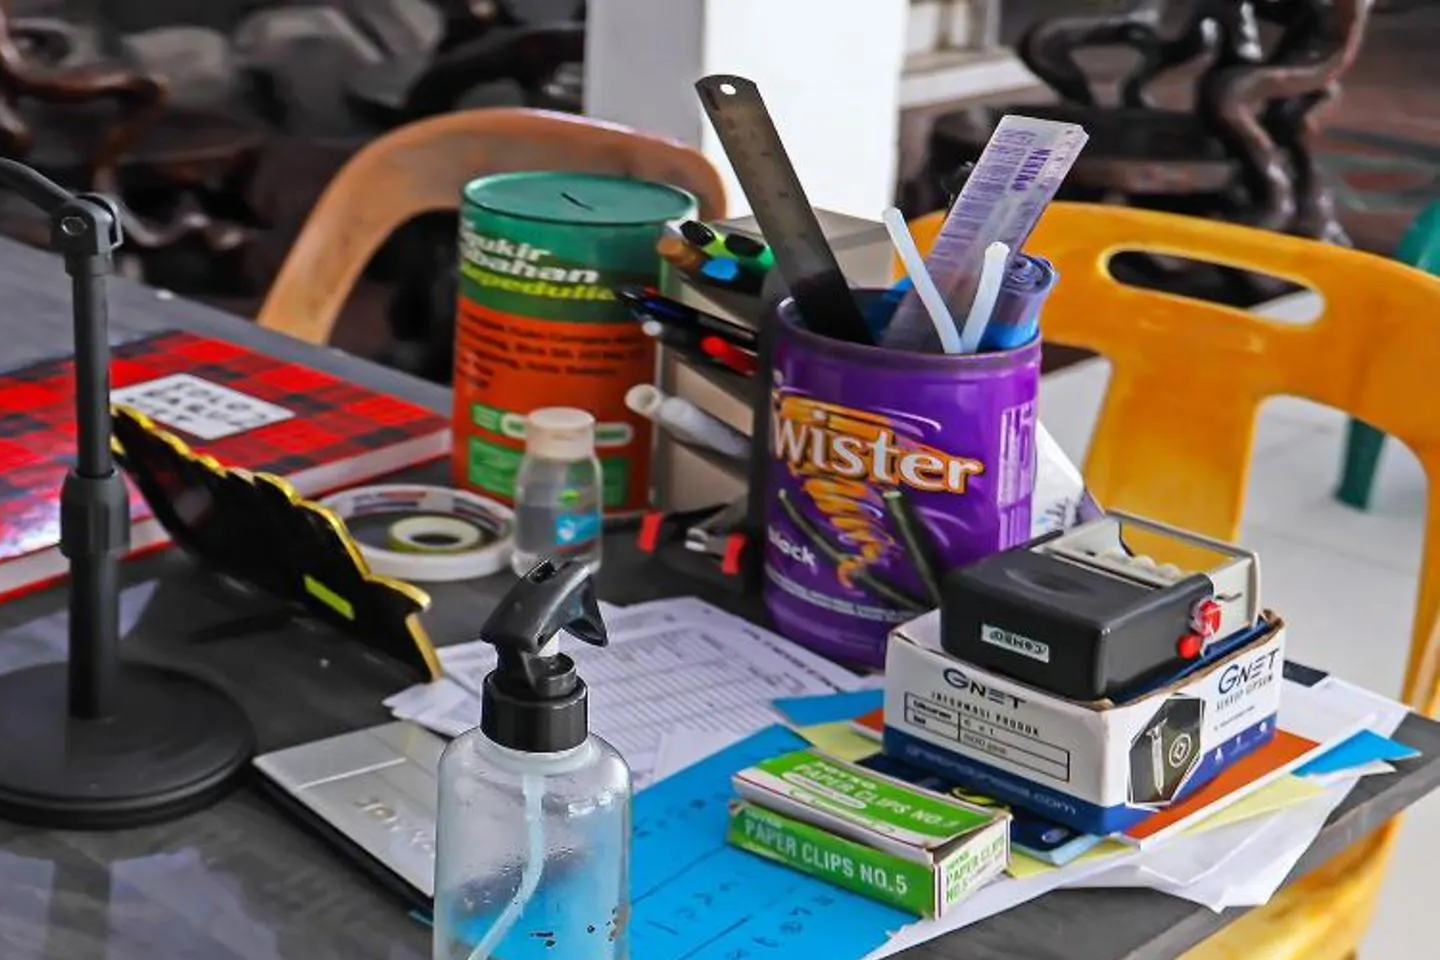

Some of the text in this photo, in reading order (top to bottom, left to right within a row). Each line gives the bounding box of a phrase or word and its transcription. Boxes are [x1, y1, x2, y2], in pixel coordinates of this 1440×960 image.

[944, 668, 1026, 709] GNET
[1218, 648, 1280, 695] GNET
[744, 817, 797, 858] PAPER
[801, 841, 855, 879] CLIPS
[860, 862, 909, 895] NO.5
